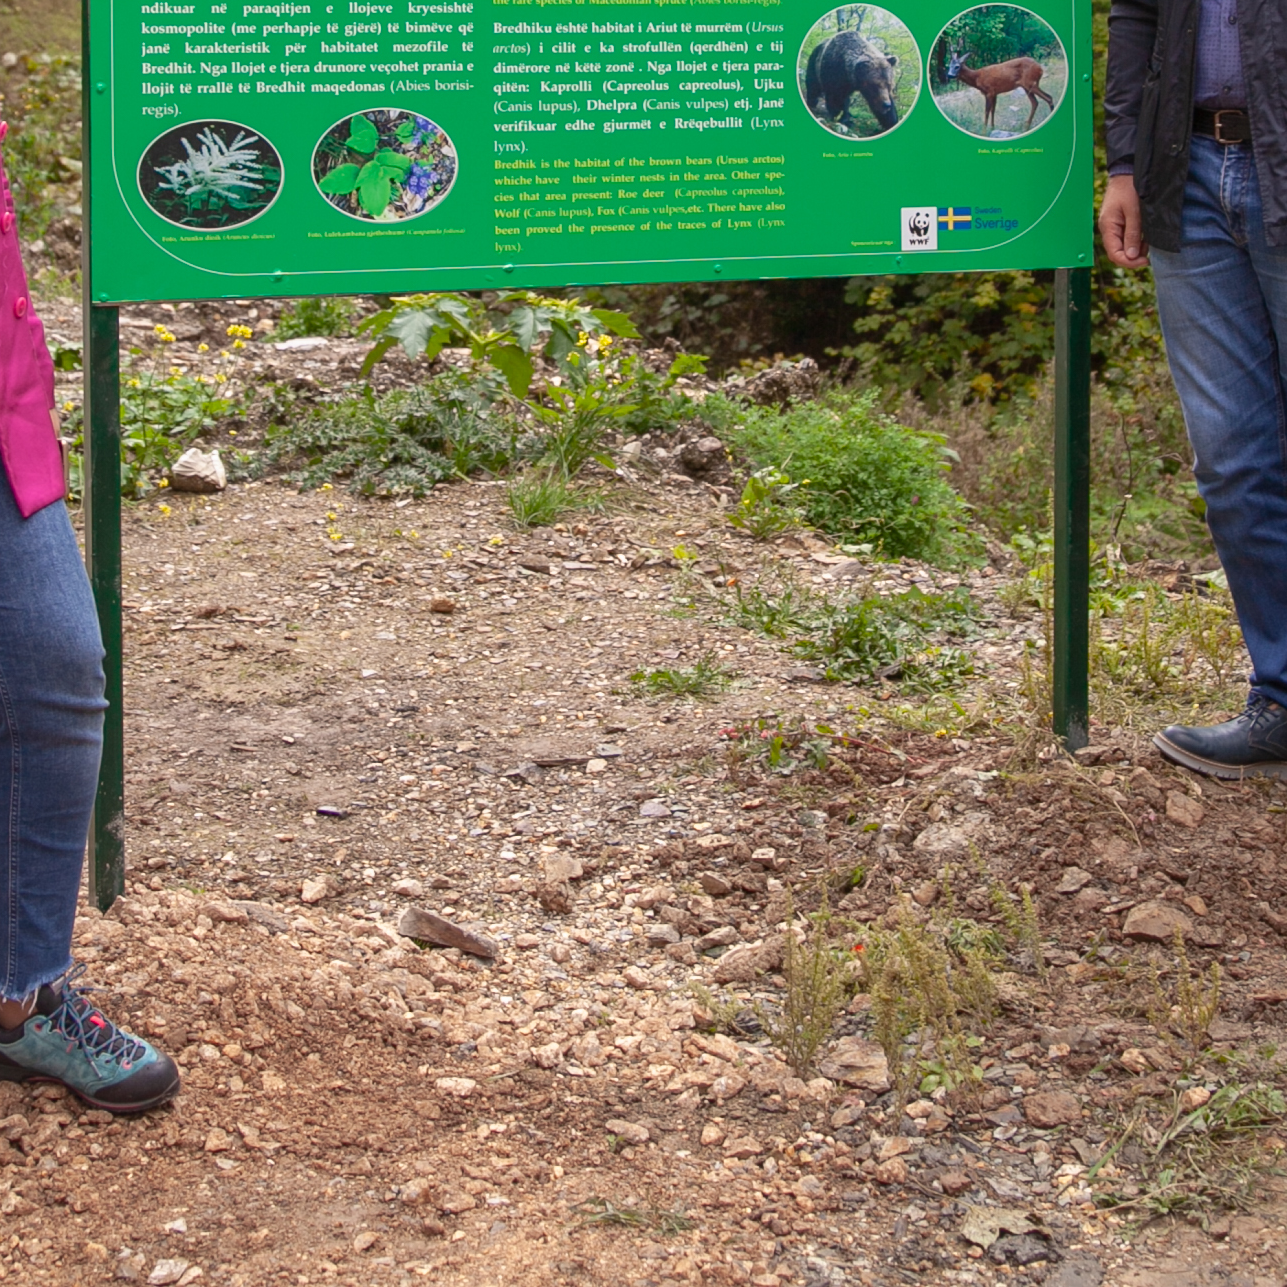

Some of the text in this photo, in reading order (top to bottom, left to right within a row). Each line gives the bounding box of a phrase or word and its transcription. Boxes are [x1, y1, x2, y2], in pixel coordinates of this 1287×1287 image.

[141, 1, 473, 17] ndikuar në paraqitjen e llojeve kryesishtë
[493, 21, 783, 34] Bredhiku është habitat i Ariut të murrëm (Ursus
[141, 40, 473, 57] janë karakteristik për habitatet mezofile të
[492, 78, 783, 96] qitën: Kaprolli (Capreolus capreolus), Ujku
[493, 116, 783, 133] verifikuar edhe gjurmët e Rrëqebullit (Lynx
[974, 206, 1002, 214] Sweden
[974, 218, 1019, 231] Sverige
[909, 238, 929, 246] WWF
